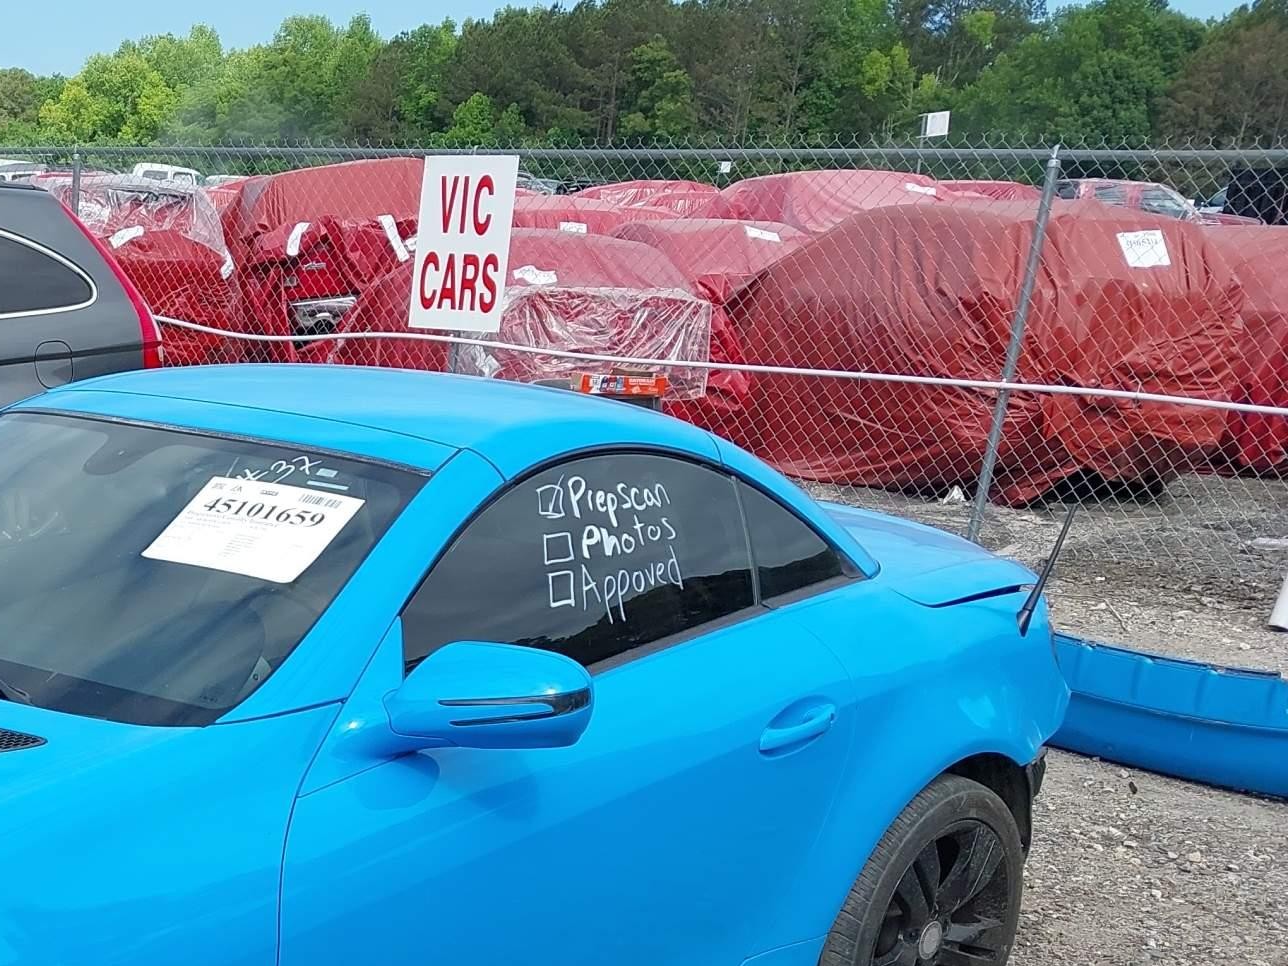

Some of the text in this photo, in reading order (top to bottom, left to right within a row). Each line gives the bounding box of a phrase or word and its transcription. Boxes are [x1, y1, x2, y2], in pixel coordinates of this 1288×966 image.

[441, 174, 495, 236] VIC
[419, 251, 500, 314] CARS
[203, 496, 326, 528] 45101659
[581, 514, 677, 559] Photos
